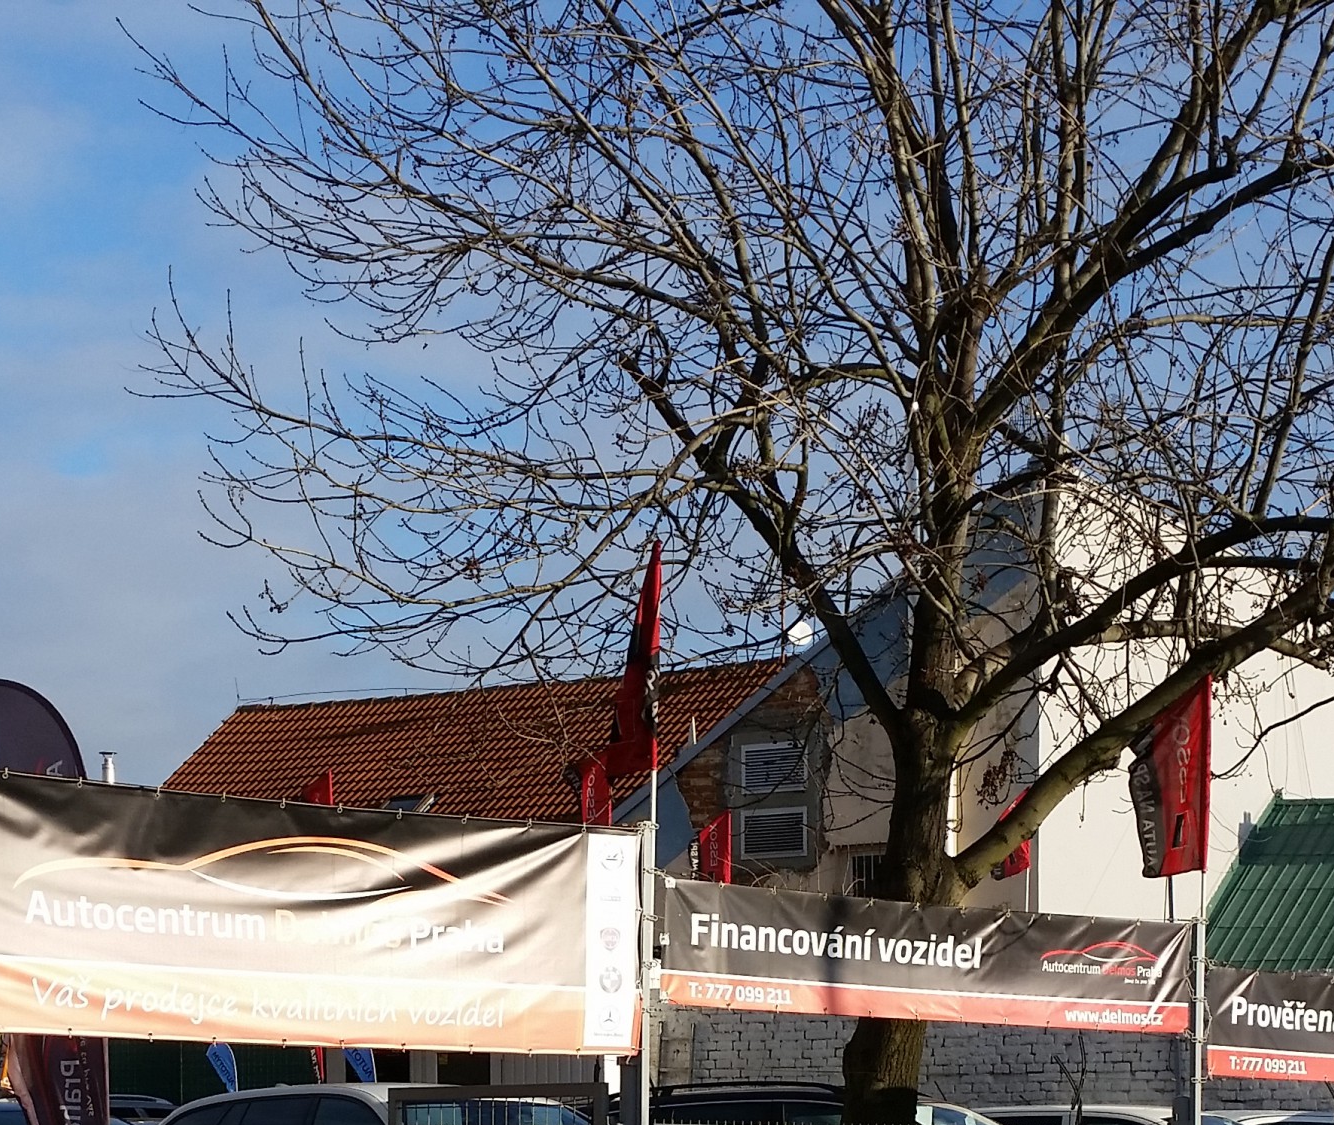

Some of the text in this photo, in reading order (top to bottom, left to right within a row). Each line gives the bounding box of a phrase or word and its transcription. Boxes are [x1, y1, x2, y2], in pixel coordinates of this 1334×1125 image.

[25, 889, 266, 942] Autocentrum
[690, 912, 983, 970] Financování vozidel
[1042, 960, 1101, 975] Autocentrum
[31, 974, 91, 1011] Váš
[102, 984, 239, 1026] prodejce
[408, 996, 505, 1029] vozidel
[688, 981, 792, 1005] T: 777 099 211
[1229, 1055, 1308, 1075] T: 777 099 211
